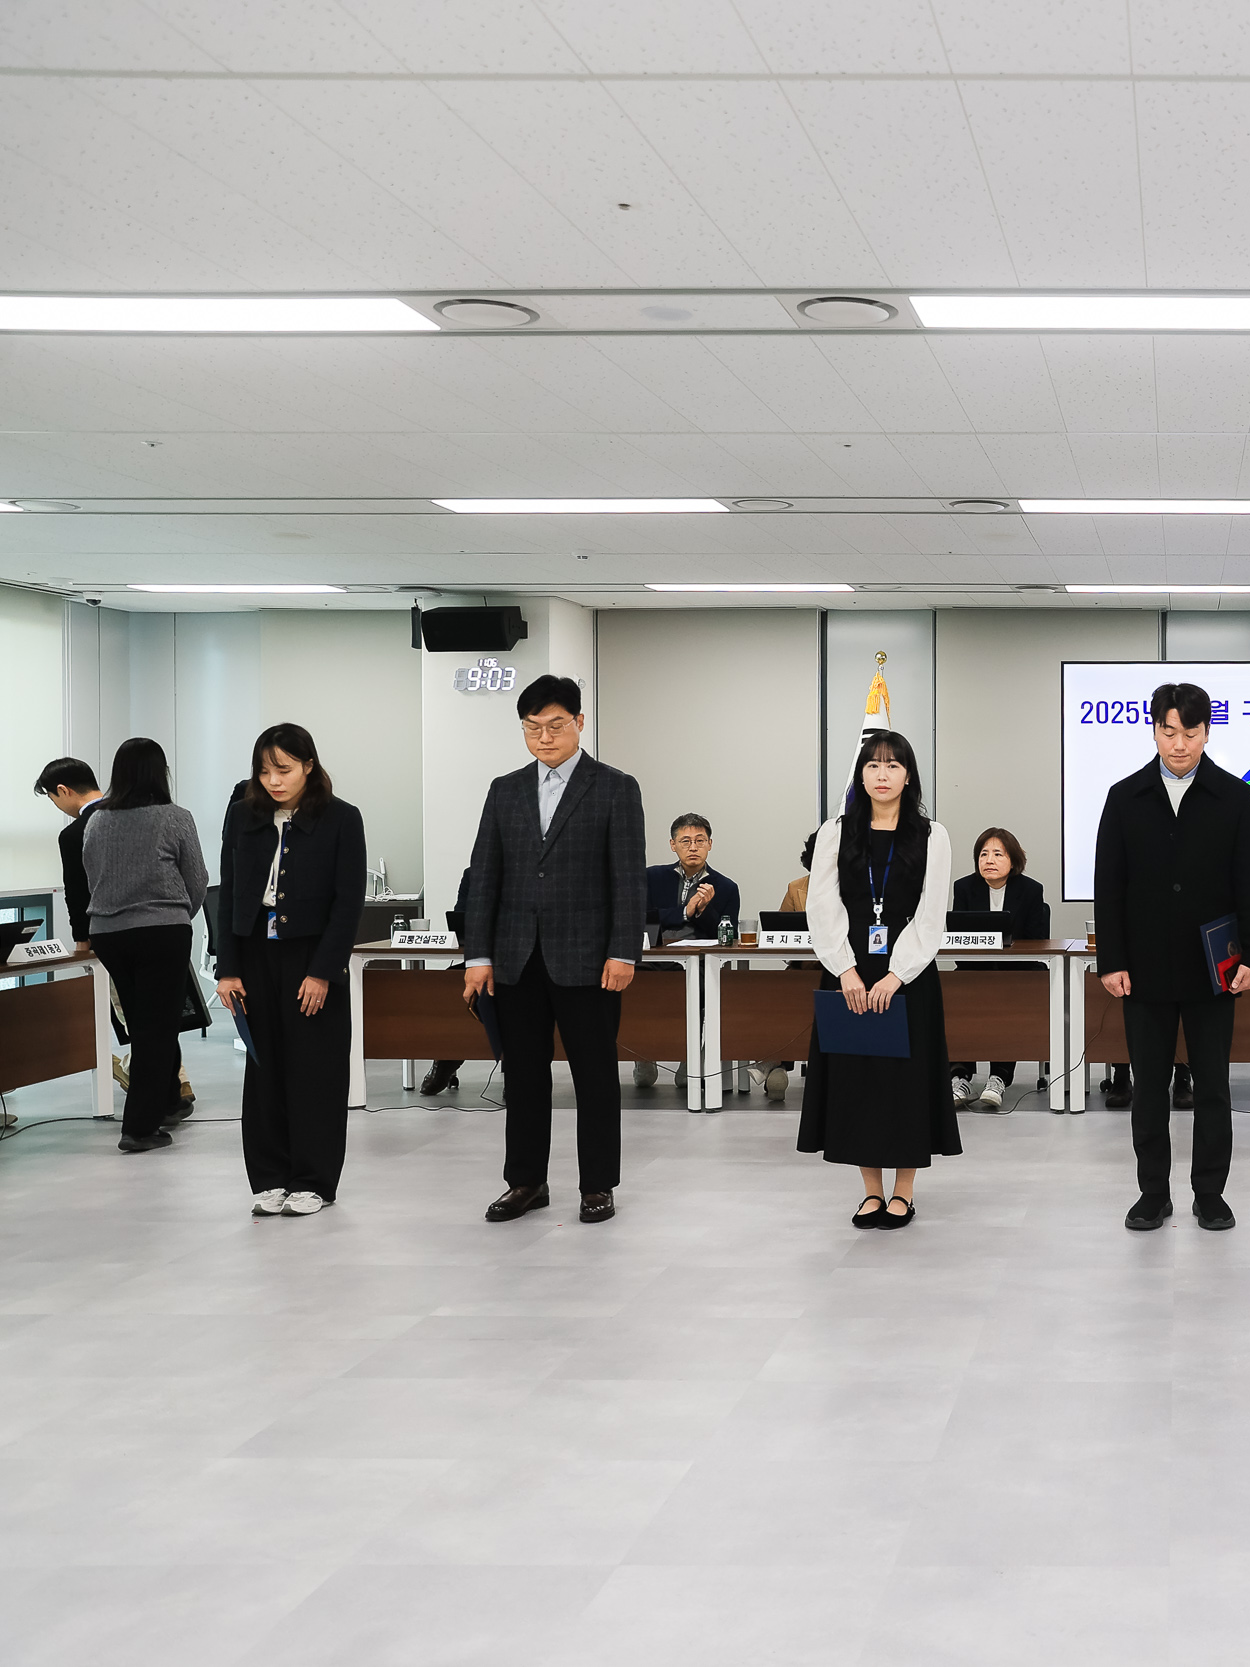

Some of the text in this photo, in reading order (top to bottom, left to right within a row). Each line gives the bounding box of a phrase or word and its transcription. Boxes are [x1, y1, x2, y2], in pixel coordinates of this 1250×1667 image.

[466, 667, 516, 691] 9:03
[398, 934, 447, 945] 교통건설국장
[945, 935, 996, 945] 기획경제국장
